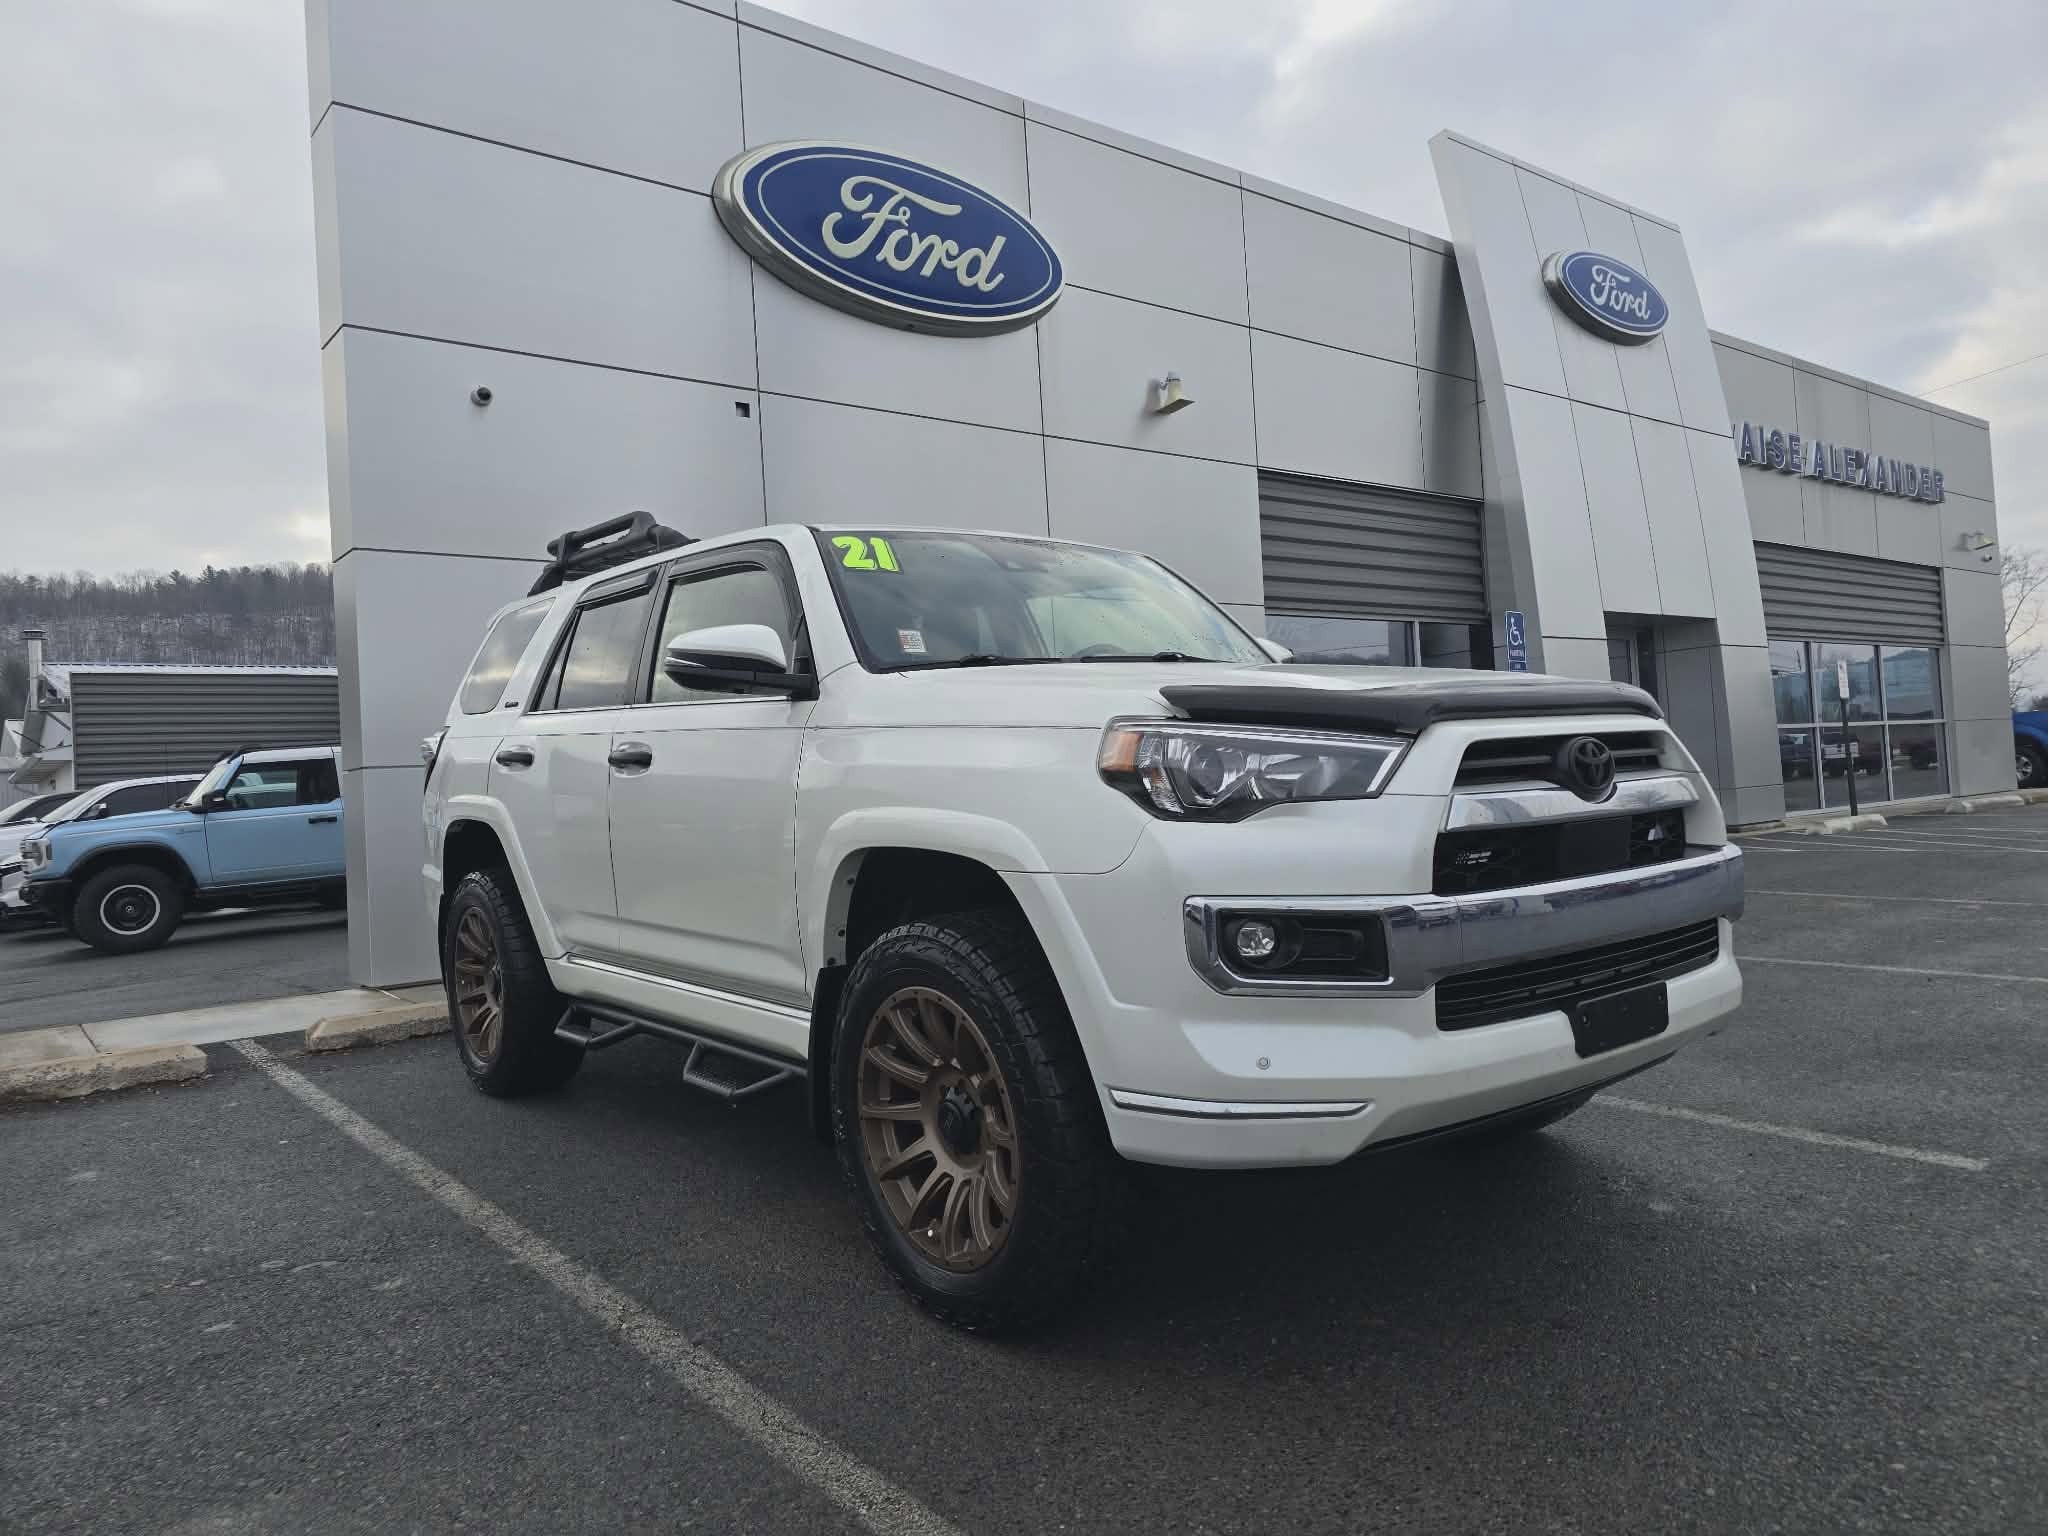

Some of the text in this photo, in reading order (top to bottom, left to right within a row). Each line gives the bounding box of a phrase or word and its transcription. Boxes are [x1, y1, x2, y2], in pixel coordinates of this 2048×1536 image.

[822, 175, 1007, 293] Ford
[1590, 265, 1651, 320] Ford
[1809, 440, 1945, 503] ALEXANDER
[831, 535, 900, 572] 21
